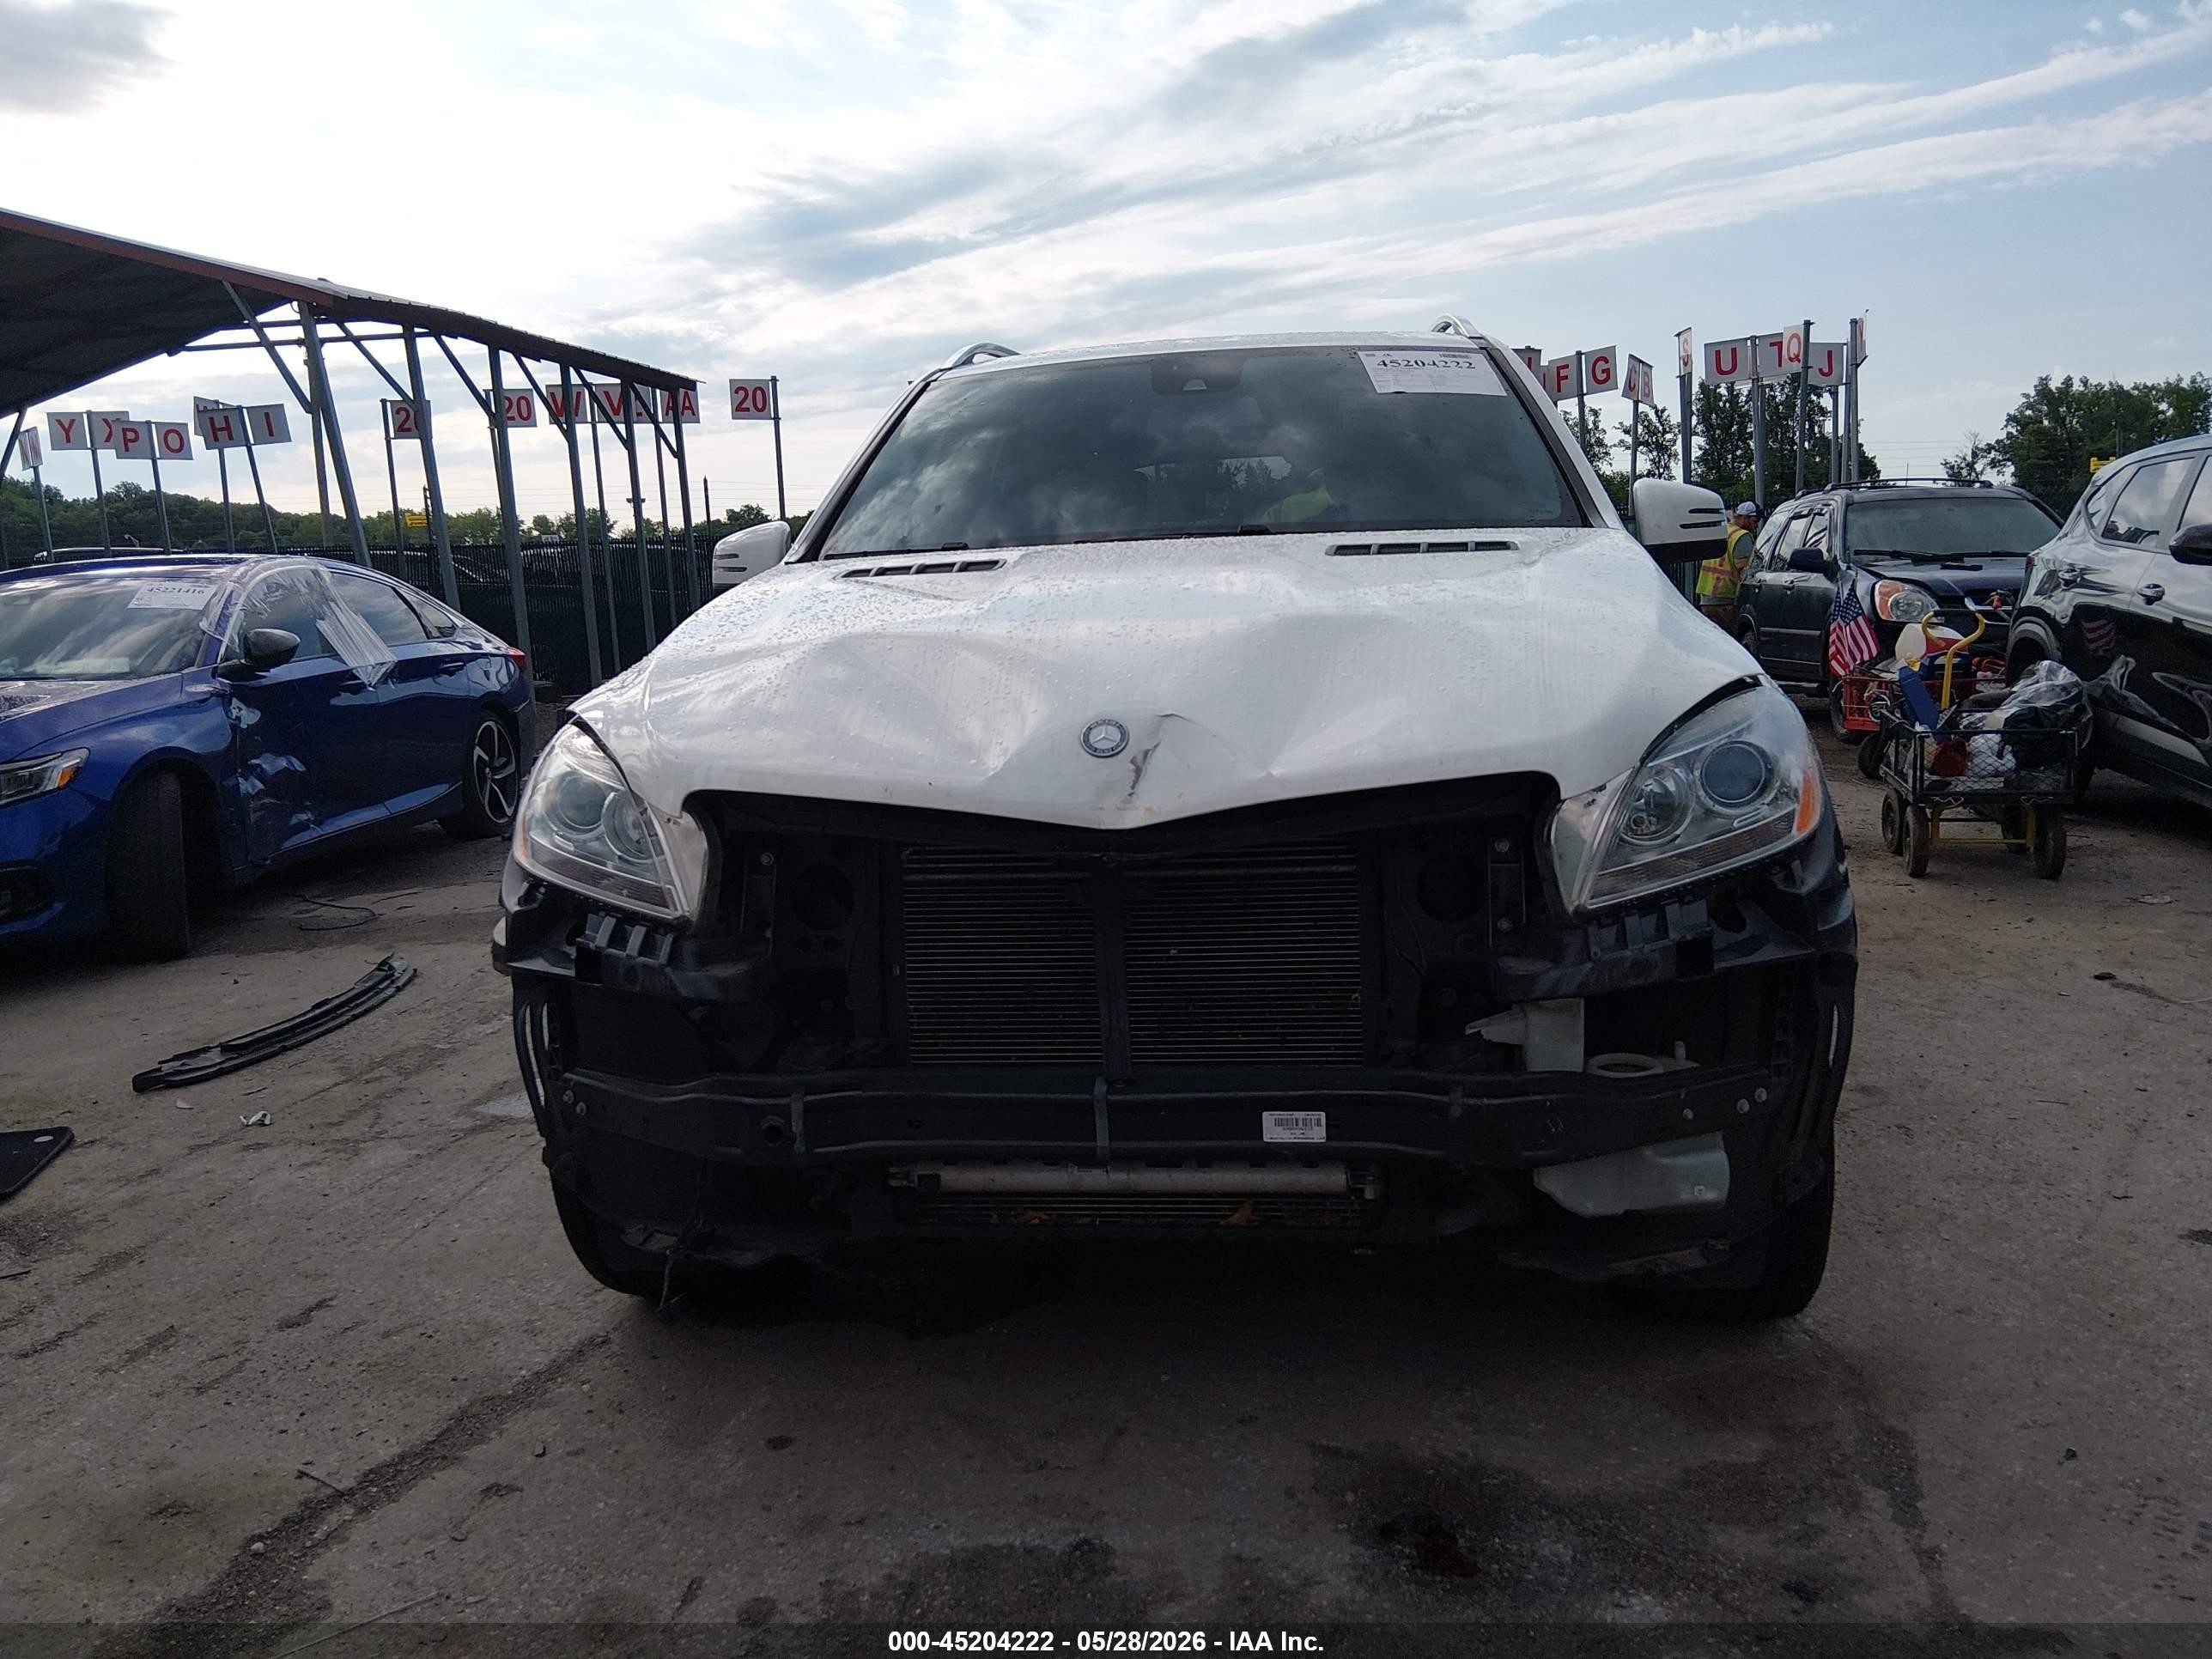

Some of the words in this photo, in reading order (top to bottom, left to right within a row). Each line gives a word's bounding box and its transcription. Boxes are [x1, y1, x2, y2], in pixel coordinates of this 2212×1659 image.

[1715, 347, 1738, 375] U
[1787, 332, 1802, 363] Q
[1376, 359, 1476, 369] 45204222
[1591, 356, 1611, 385] G
[1819, 349, 1833, 377] J
[1556, 364, 1570, 392] F
[1629, 364, 1637, 392] C
[1644, 371, 1650, 398] B
[503, 395, 532, 421] 20
[734, 386, 768, 412] 20
[55, 418, 76, 444] Y
[209, 415, 234, 442] H
[264, 411, 275, 437] I
[122, 427, 140, 453] P
[162, 428, 185, 453] O
